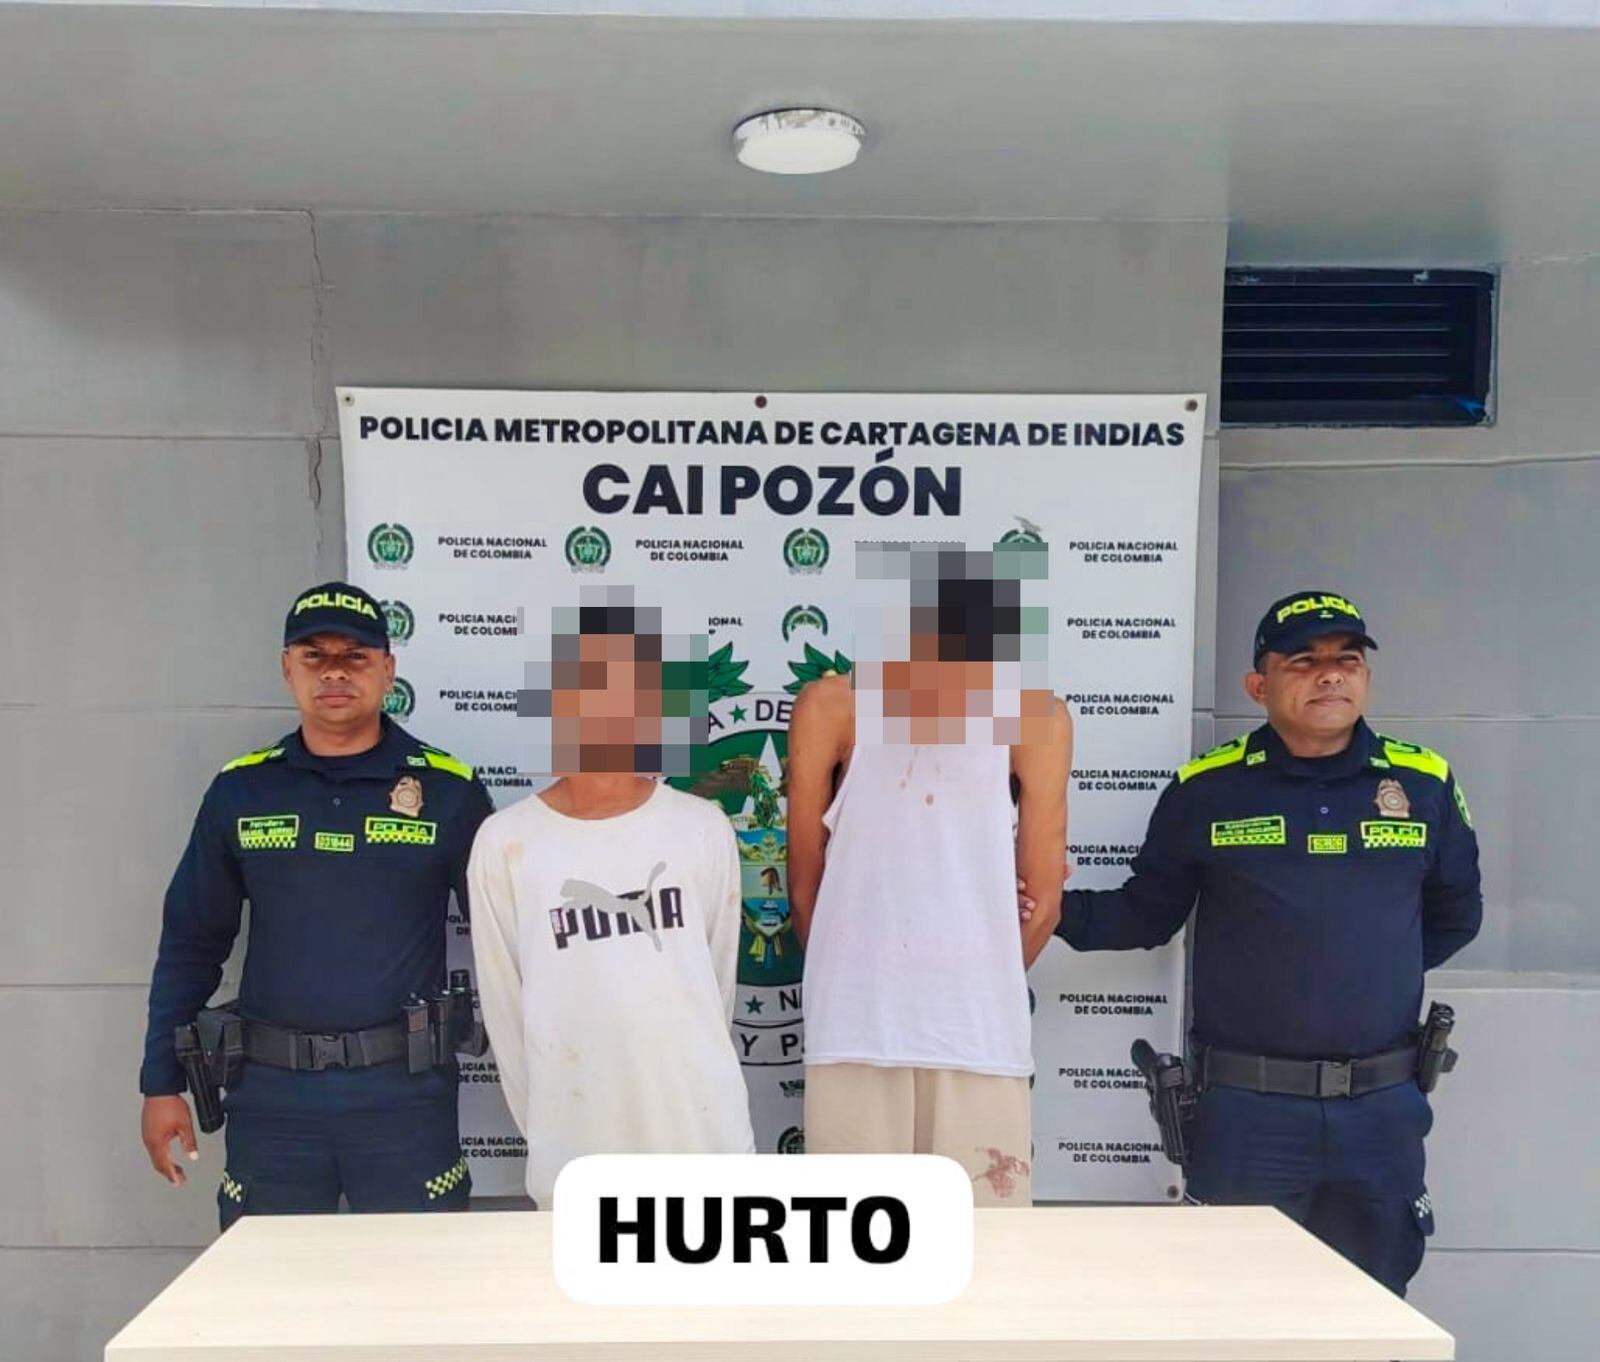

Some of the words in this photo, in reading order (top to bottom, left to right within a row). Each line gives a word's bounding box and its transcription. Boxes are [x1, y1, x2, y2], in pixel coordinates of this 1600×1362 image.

[361, 416, 487, 441] POLICIA
[495, 419, 767, 444] METROPOLITANA
[775, 421, 813, 445] DE
[821, 422, 1020, 446] CARTAGENA
[1028, 423, 1066, 446] DE
[1075, 423, 1184, 446] INDIAS
[583, 464, 703, 515] CAI
[721, 448, 962, 516] POZÓN
[438, 537, 484, 546] POLICIA
[487, 537, 547, 547] NACIONAL
[635, 539, 681, 549] POLICIA
[683, 539, 744, 549] NACIONAL
[1069, 541, 1115, 551] POLICIA
[1117, 541, 1178, 551] NACIONAL
[453, 549, 467, 558] DE
[470, 549, 532, 559] COLOMBIA
[650, 552, 664, 561] DE
[667, 552, 729, 561] COLOMBIA
[1084, 553, 1098, 562] DE
[1101, 553, 1162, 562] COLOMBIA
[438, 614, 485, 623] POLICIA
[487, 614, 517, 623] NACI
[709, 617, 743, 626] IONAL
[1067, 617, 1113, 627] POLICIA
[1115, 617, 1176, 627] NACIONAL
[454, 626, 469, 635] DE
[1082, 630, 1096, 639] DE
[1098, 630, 1161, 639] COLOMBIA
[439, 690, 485, 699] POLICIA
[487, 690, 517, 699] NACI
[1066, 694, 1111, 703] POLICIA
[1113, 694, 1174, 703] NACIONAL
[455, 702, 469, 711] DE
[756, 699, 794, 722] DE
[1080, 706, 1094, 715] DE
[1097, 706, 1159, 715] COLOMBIA
[1071, 770, 1108, 778] OLICIA
[1079, 781, 1092, 790] DE
[1095, 781, 1157, 790] COLOMBIA
[1066, 845, 1108, 854] OLICIA
[1110, 845, 1139, 854] NACI
[1077, 857, 1091, 866] DE
[549, 887, 684, 949] PUMA
[1059, 994, 1105, 1003] POLICIA
[1107, 994, 1168, 1004] NACIONAL
[1074, 1005, 1089, 1015] DE
[1091, 1005, 1153, 1015] COLOMBIA
[1059, 1068, 1104, 1077] POLICIA
[1074, 1080, 1088, 1089] DE
[1058, 1142, 1103, 1151] POLICIA
[1073, 1154, 1087, 1163] DE
[1089, 1154, 1151, 1163] COLOMBIA
